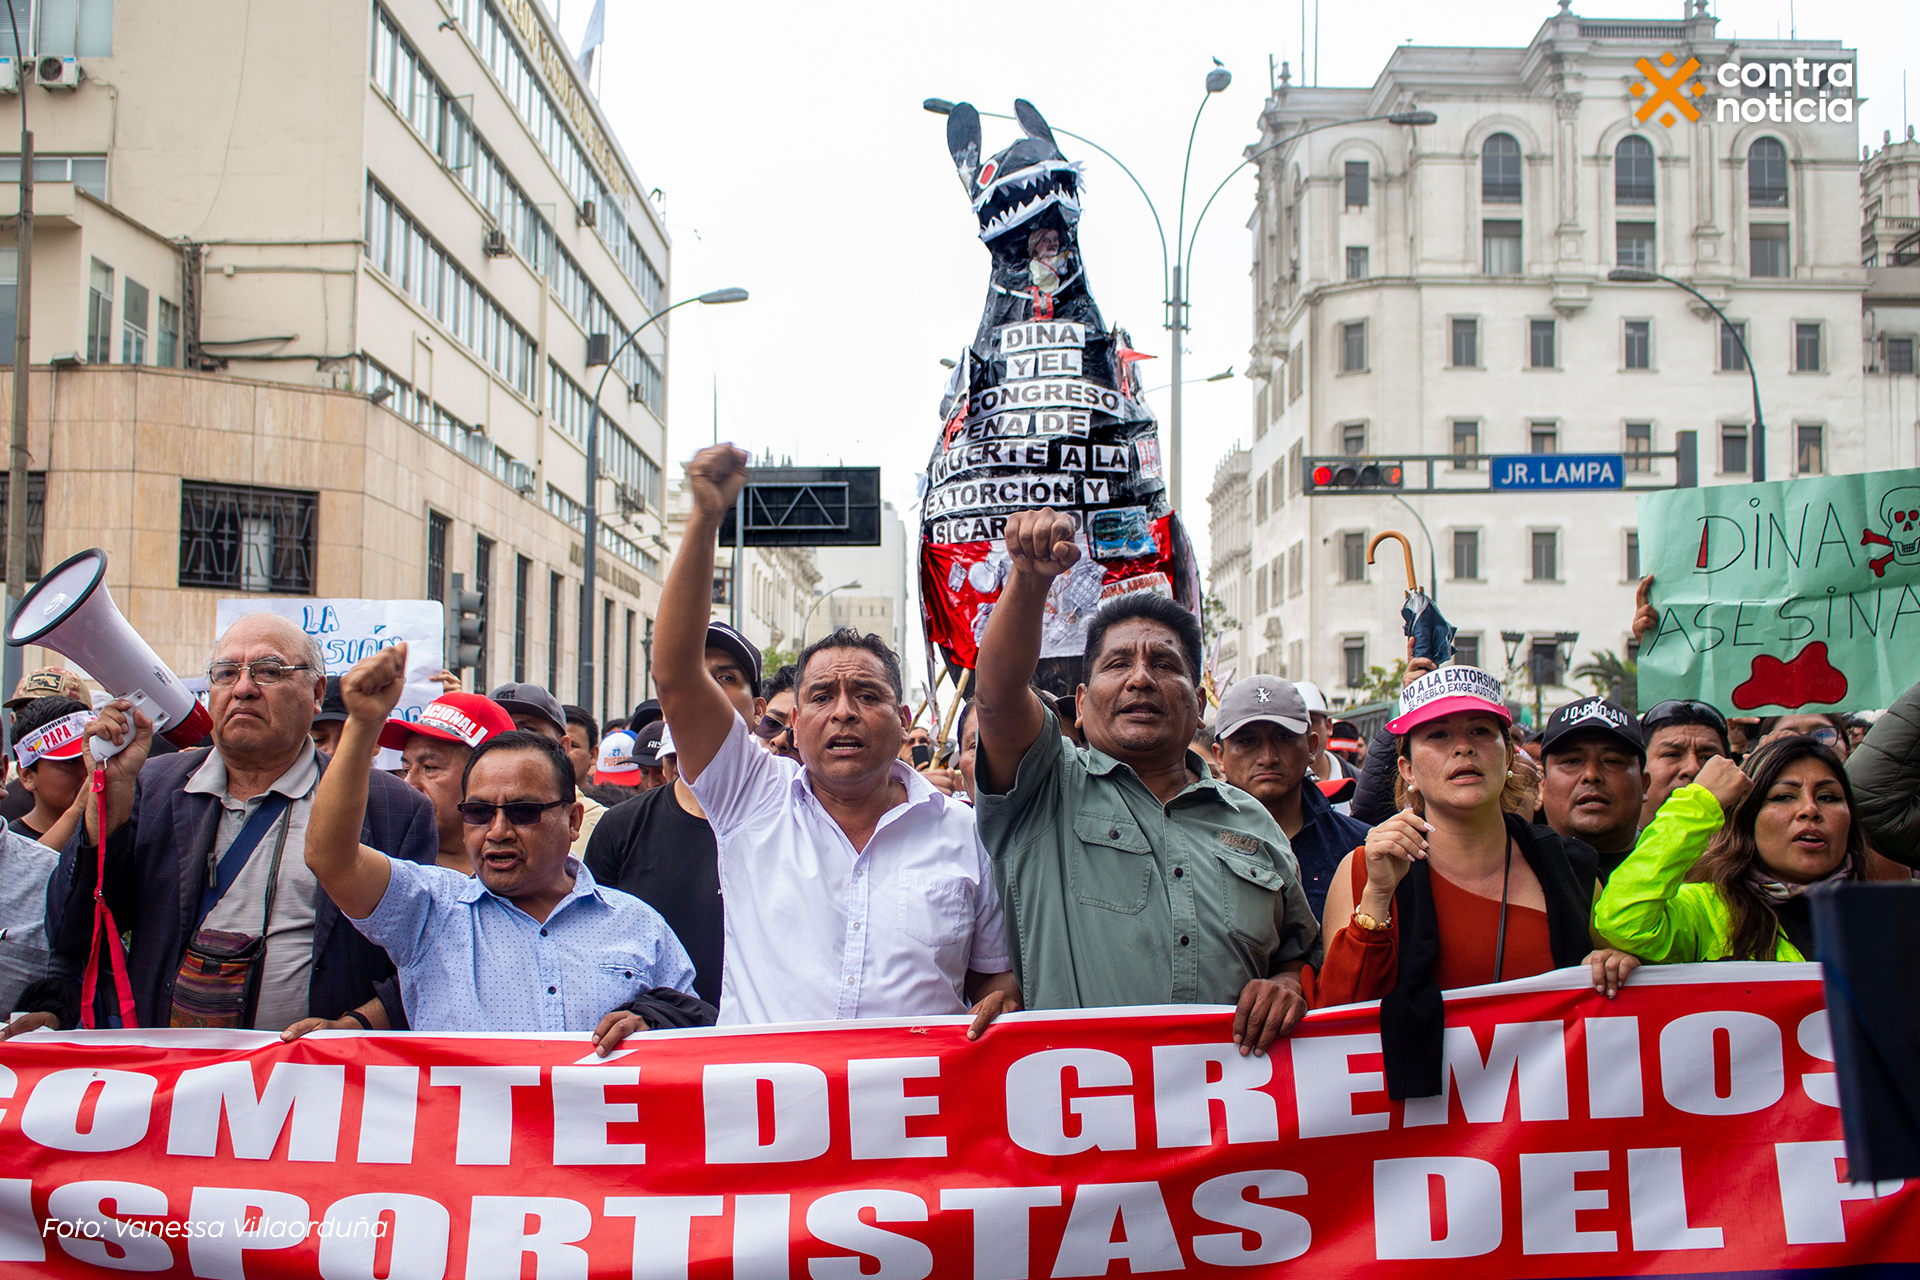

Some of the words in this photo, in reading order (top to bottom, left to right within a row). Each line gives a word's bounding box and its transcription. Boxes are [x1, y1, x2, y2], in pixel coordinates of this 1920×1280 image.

[1006, 325, 1080, 349] DINA
[1013, 358, 1032, 376] Y
[1041, 353, 1078, 371] EL
[968, 384, 1119, 417] CONGRESO
[1042, 414, 1087, 436] DE
[934, 442, 1047, 483] MUERTE
[1063, 450, 1082, 468] A
[1096, 449, 1126, 468] LA
[1501, 463, 1536, 484] JR.
[1541, 462, 1615, 484] LAMPA
[927, 477, 1074, 516] EXTORCIÓN
[1086, 482, 1103, 500] Y
[1101, 584, 1125, 600] DINA
[303, 604, 340, 635] LA
[1402, 687, 1416, 704] NO
[1418, 681, 1425, 693] A
[1427, 673, 1442, 688] LA
[1408, 700, 1416, 710] EL
[1416, 684, 1445, 708] PUEBLO
[1448, 682, 1473, 692] EXIGE
[43, 725, 72, 749] PAPA
[0, 1049, 647, 1166] OMITÉ
[703, 1056, 948, 1164] DE
[1374, 1147, 1724, 1260] DEL
